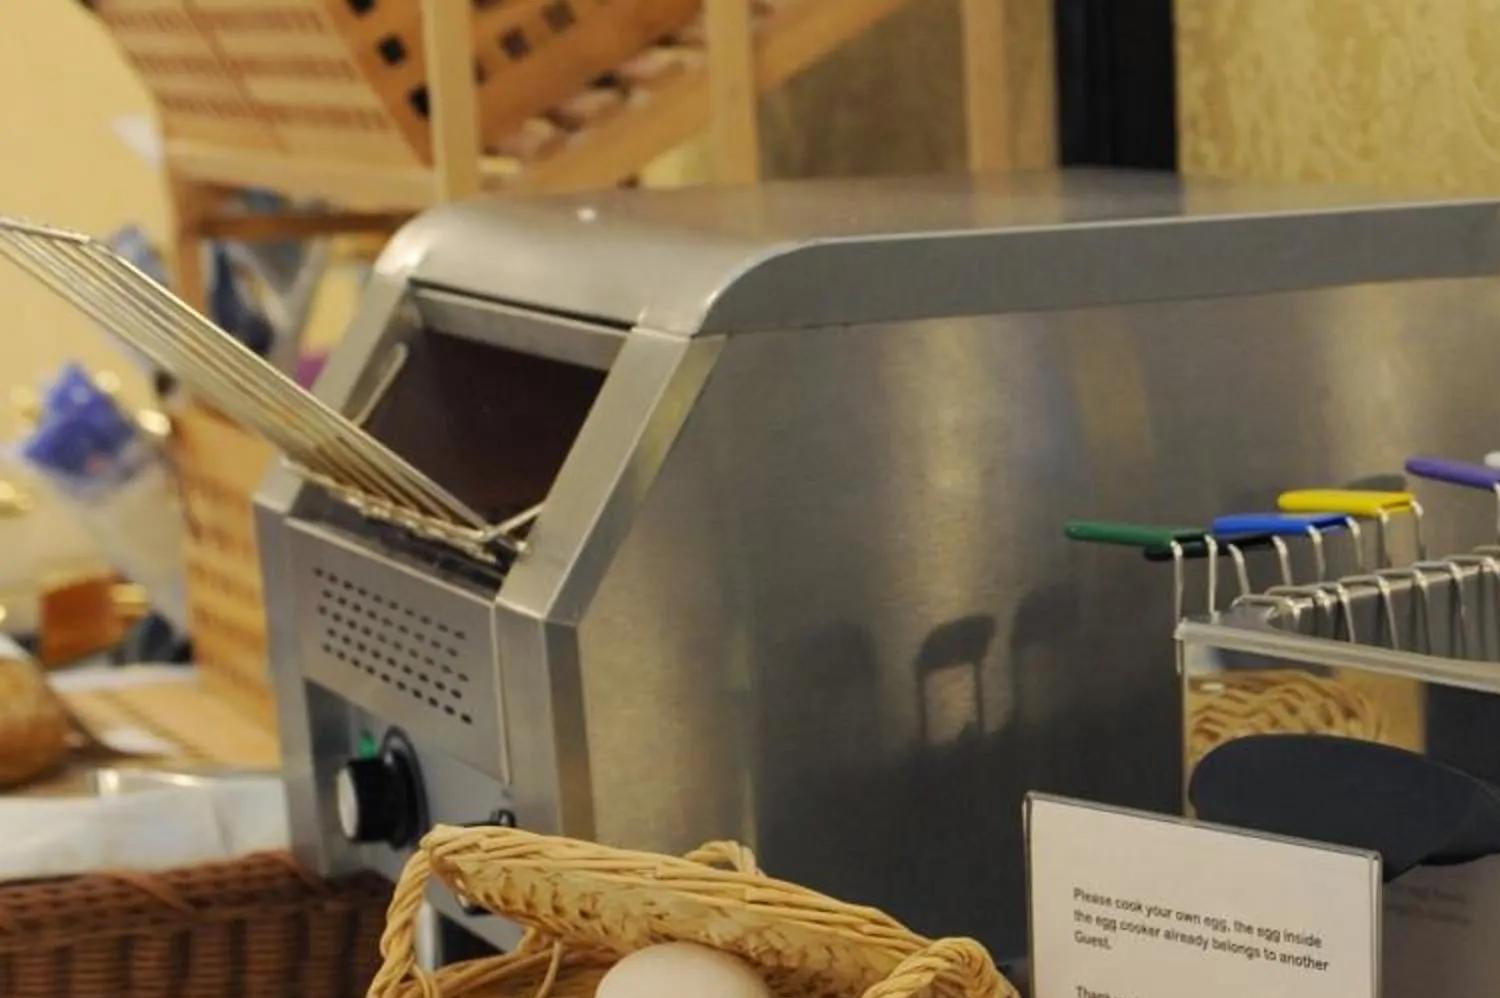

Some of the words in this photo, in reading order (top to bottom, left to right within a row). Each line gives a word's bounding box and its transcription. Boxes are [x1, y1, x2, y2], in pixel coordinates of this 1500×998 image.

[1074, 887, 1112, 906] Please
[1115, 898, 1143, 912] cook
[1145, 904, 1172, 918] your
[1176, 910, 1200, 924] own
[1234, 920, 1254, 935] the
[1257, 926, 1281, 943] egg
[1283, 929, 1322, 948] inside
[1074, 909, 1092, 923] the
[1095, 916, 1117, 932] egg
[1120, 920, 1160, 937] cooker
[1163, 929, 1209, 950] already
[1212, 937, 1261, 959] belongs
[1263, 947, 1277, 960] to
[1279, 952, 1329, 971] another
